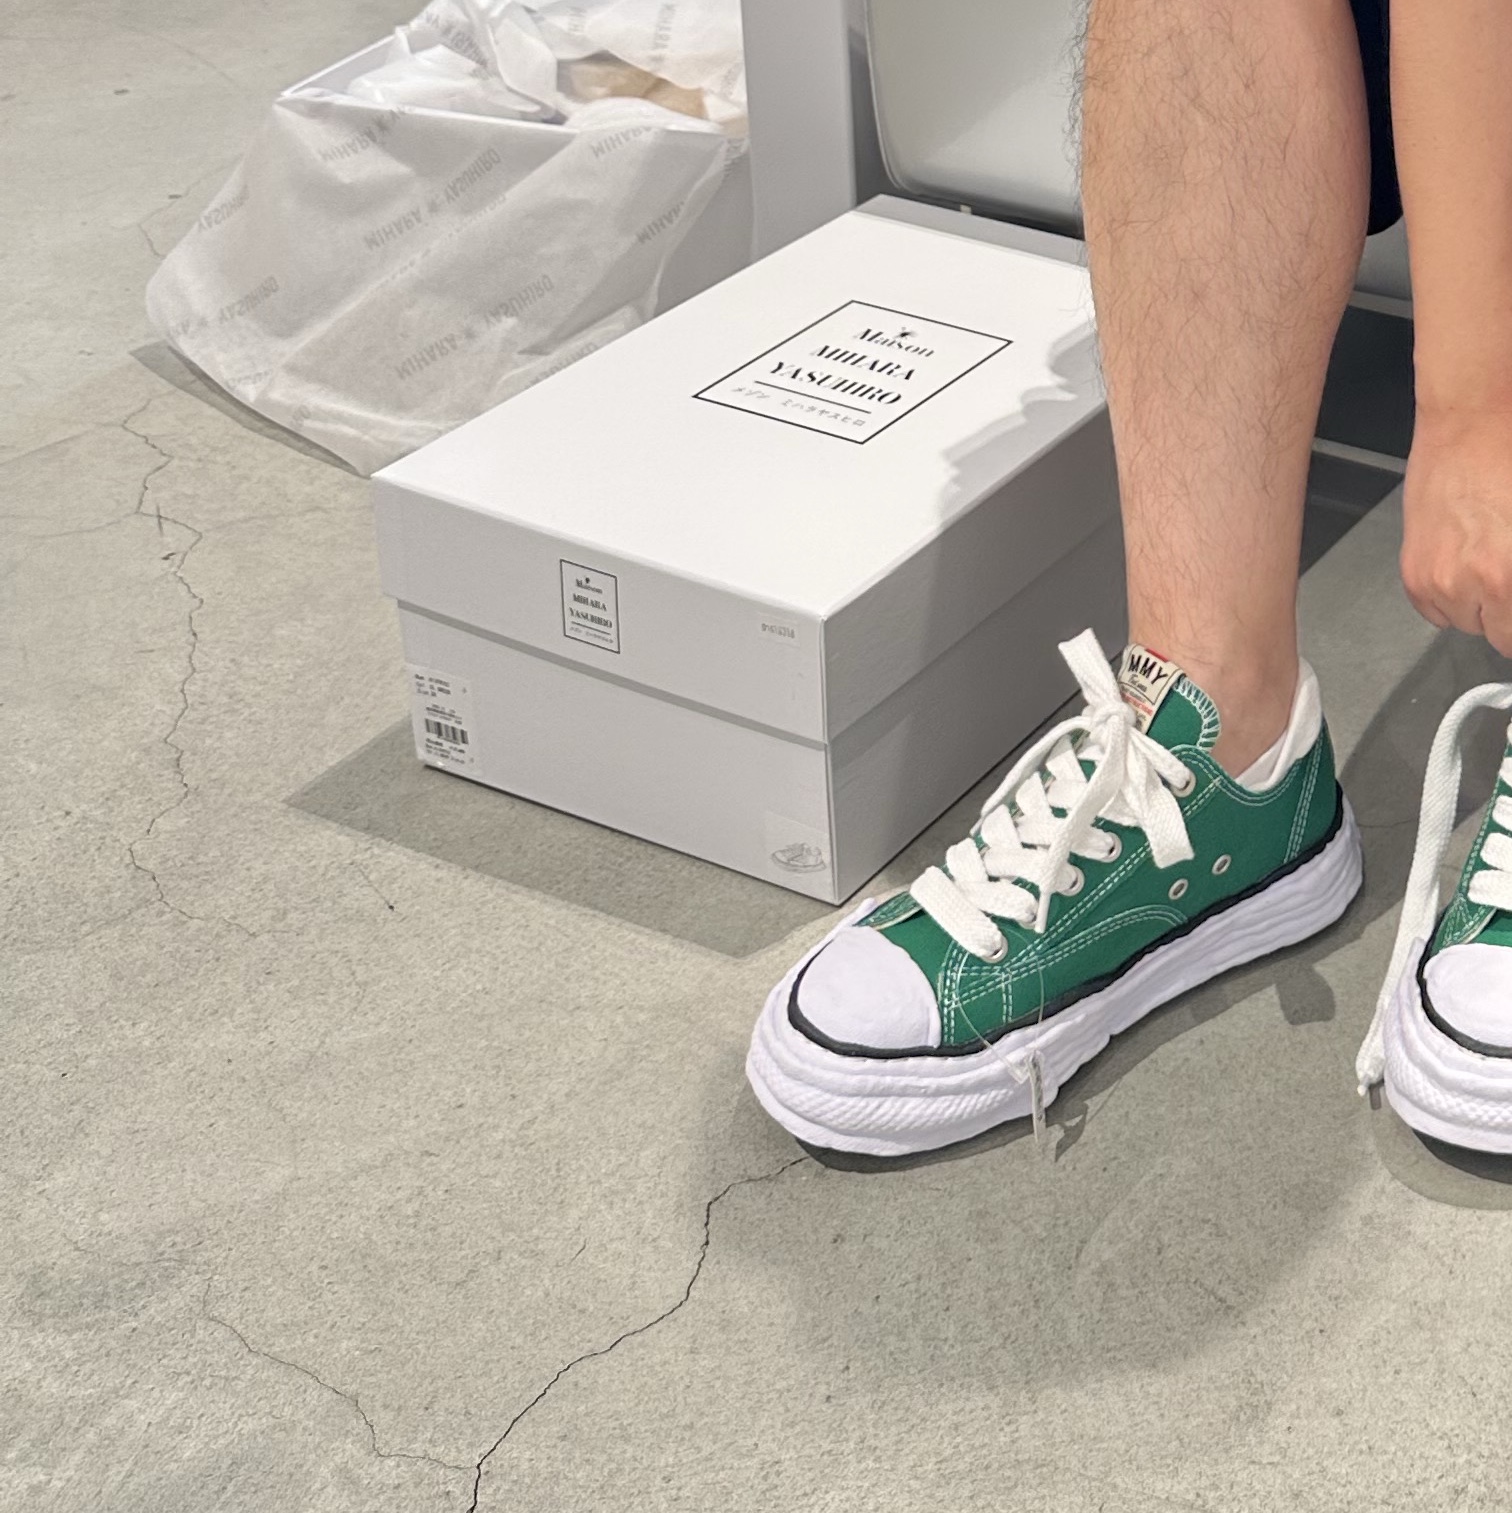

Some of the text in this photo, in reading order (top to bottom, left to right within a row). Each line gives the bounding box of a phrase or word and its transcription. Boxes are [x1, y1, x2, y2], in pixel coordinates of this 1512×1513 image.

[853, 328, 934, 358] Maison
[810, 345, 915, 380] MIHARA
[769, 361, 902, 405] YASUHIRO
[568, 606, 613, 629] YASUHIRO
[572, 593, 607, 612] MIHARA
[1128, 653, 1168, 685] MMY
